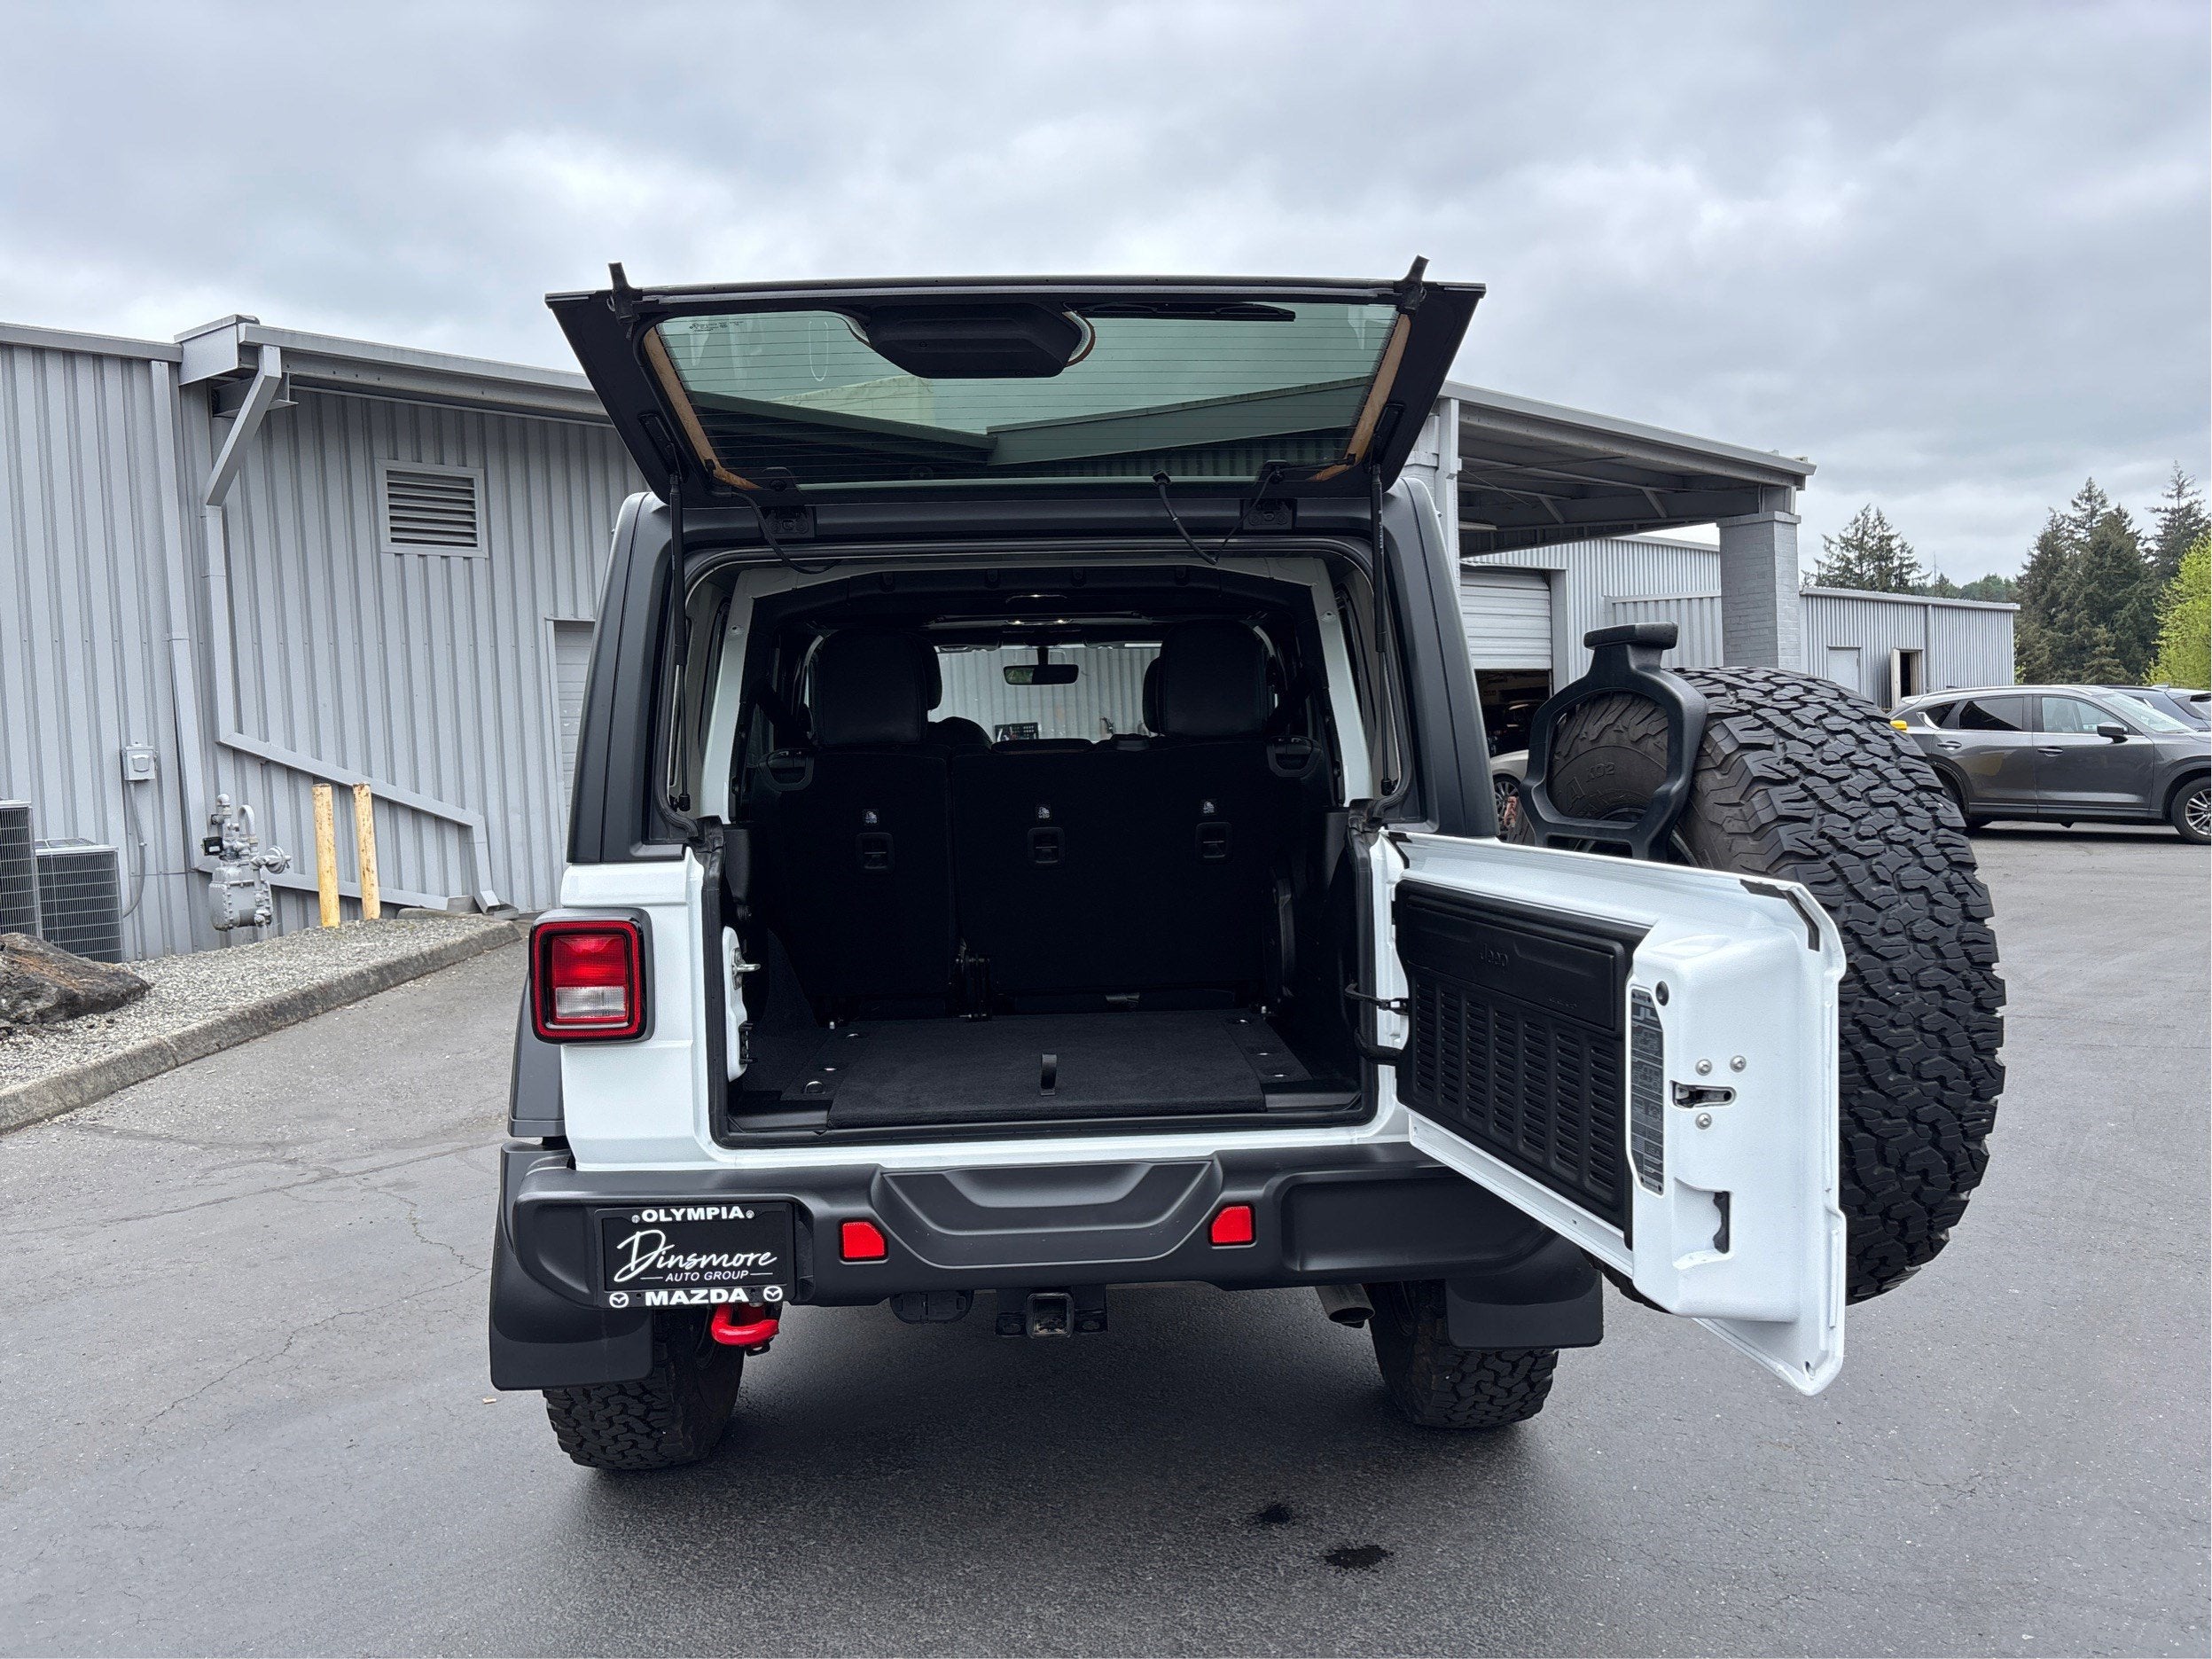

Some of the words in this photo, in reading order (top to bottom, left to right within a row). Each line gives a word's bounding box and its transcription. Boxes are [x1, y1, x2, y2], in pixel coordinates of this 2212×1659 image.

[1479, 943, 1509, 971] Jeep
[641, 1206, 745, 1223] OLYMPIA
[614, 1229, 778, 1283] Dinsmore
[665, 1272, 700, 1282] AUTO
[704, 1270, 749, 1281] GROUP
[645, 1287, 750, 1306] MAZDA
